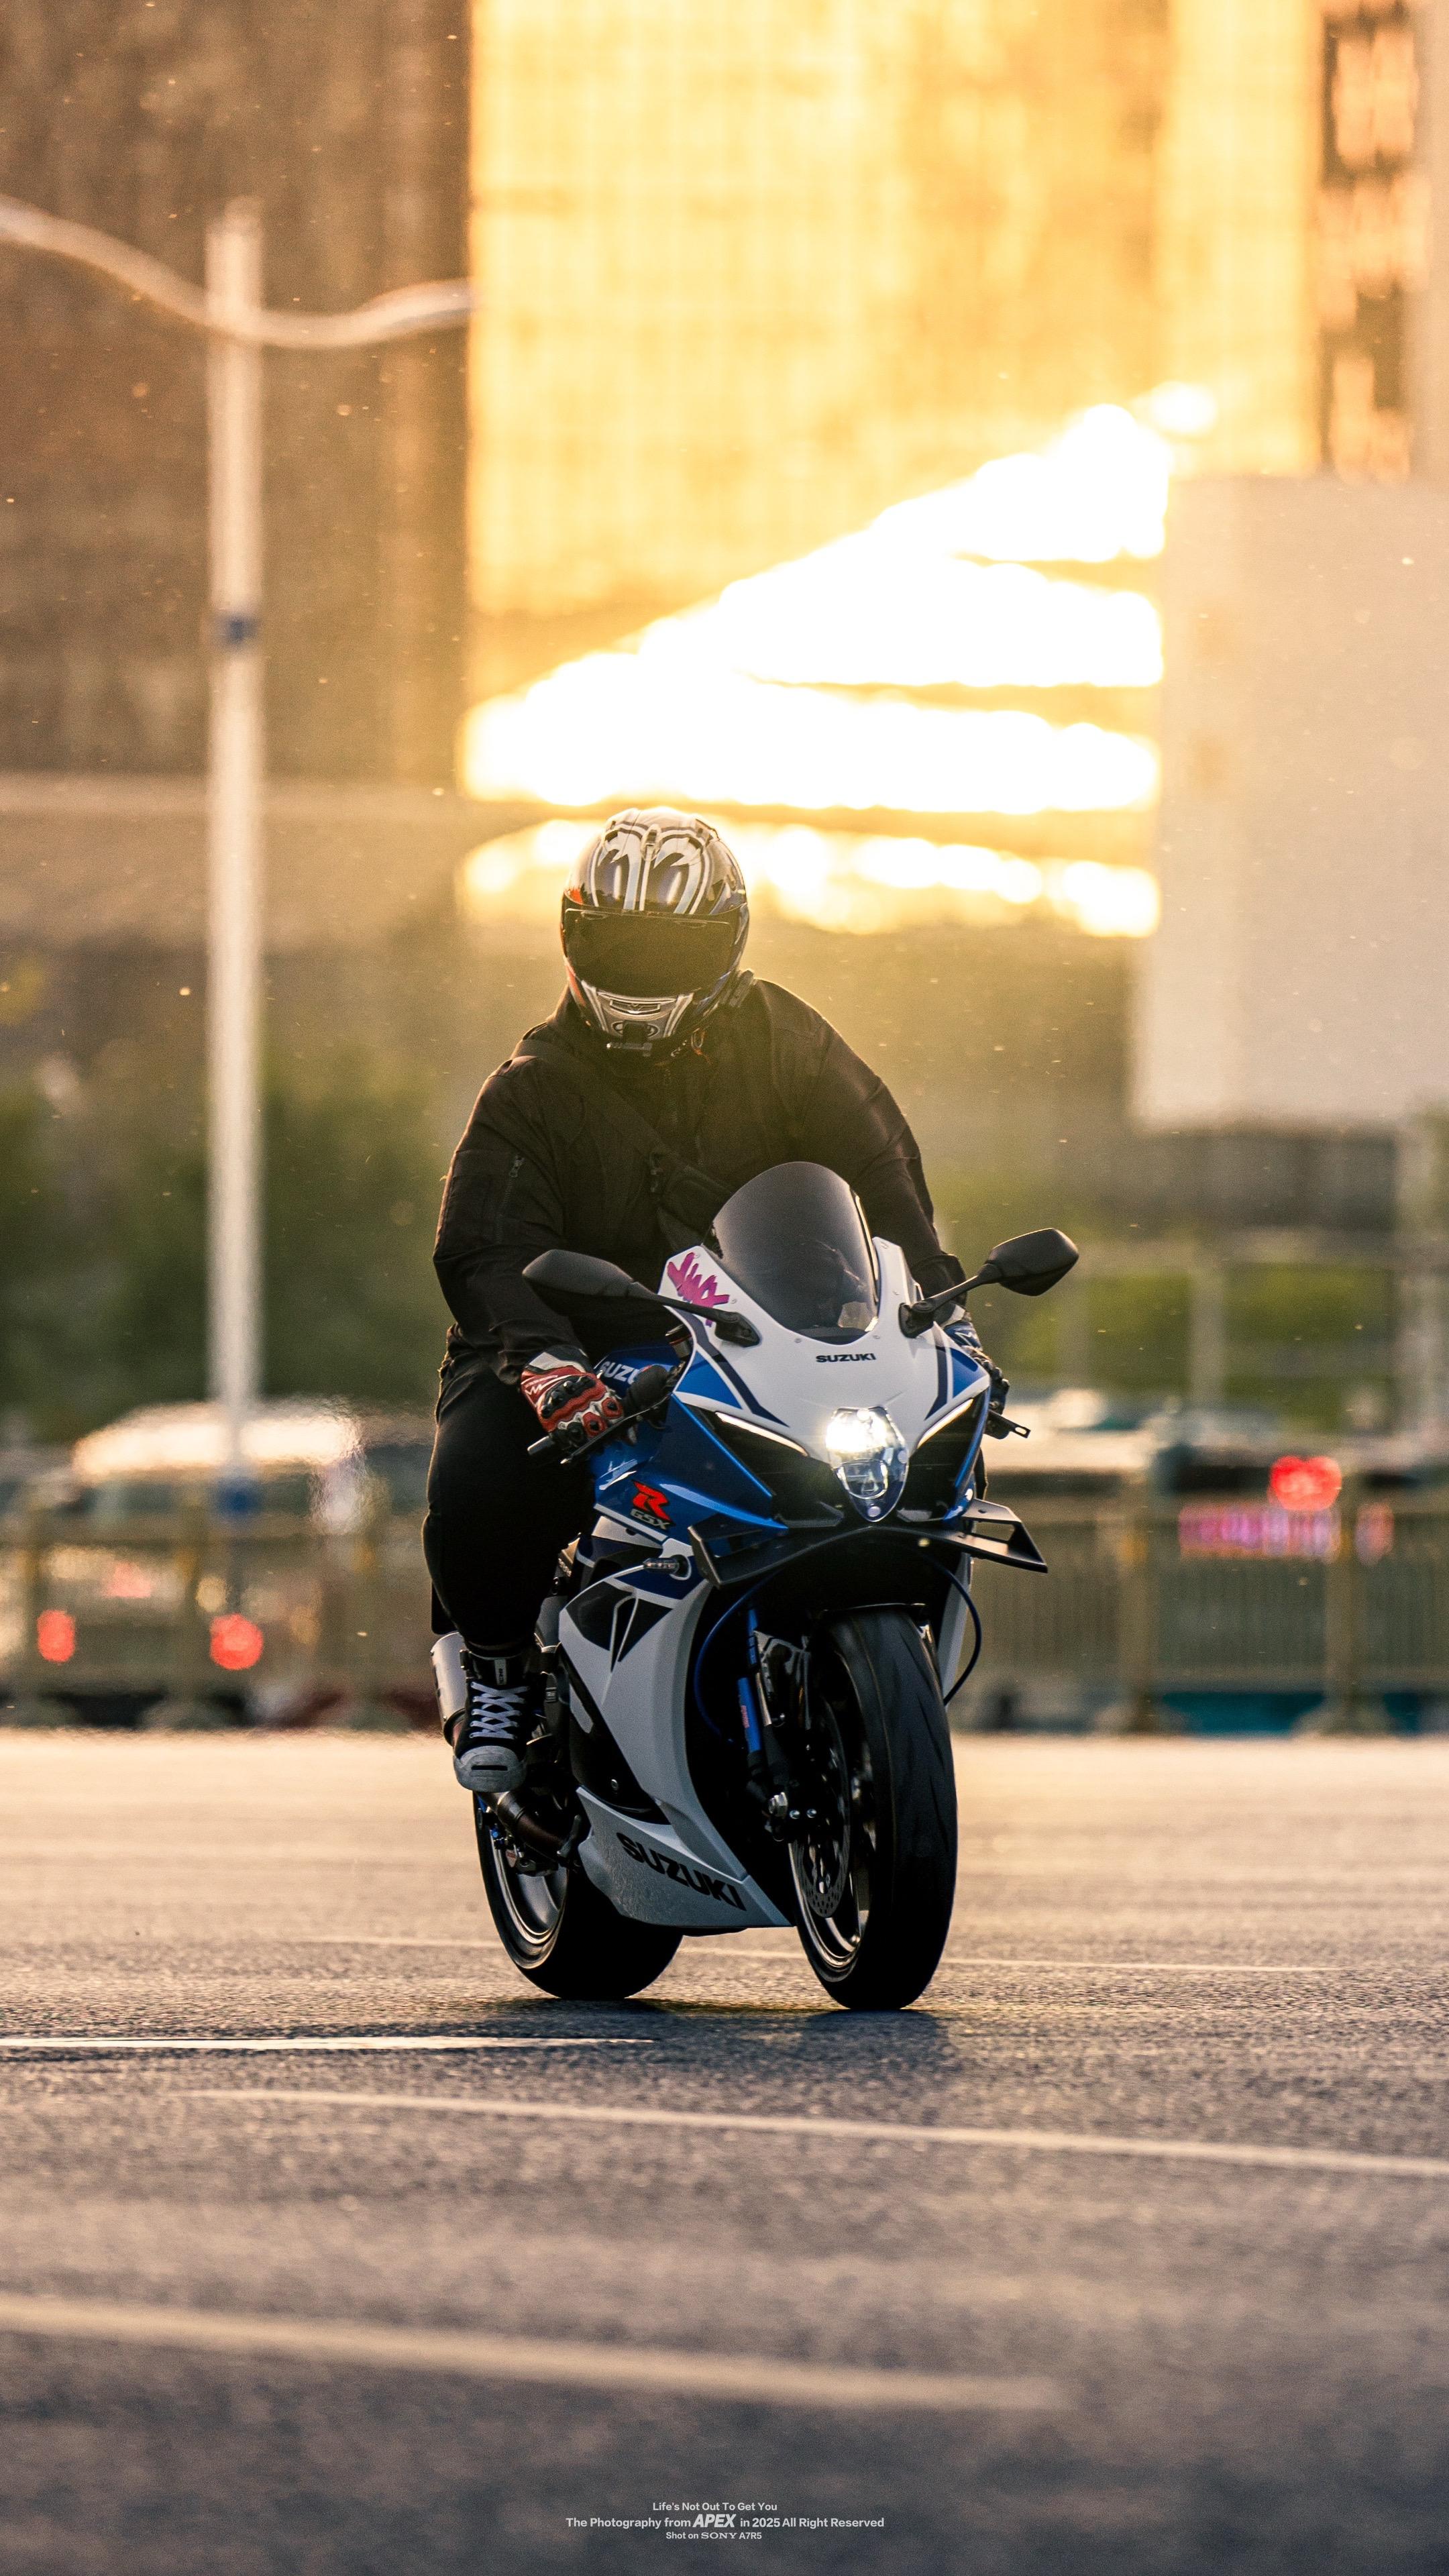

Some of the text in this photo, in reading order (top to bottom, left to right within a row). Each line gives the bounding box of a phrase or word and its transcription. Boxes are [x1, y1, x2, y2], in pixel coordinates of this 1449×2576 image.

[816, 1353, 876, 1362] SUZUKI
[633, 1481, 673, 1523] R
[631, 1509, 670, 1530] GSX
[616, 1832, 747, 1912] SUZUKI
